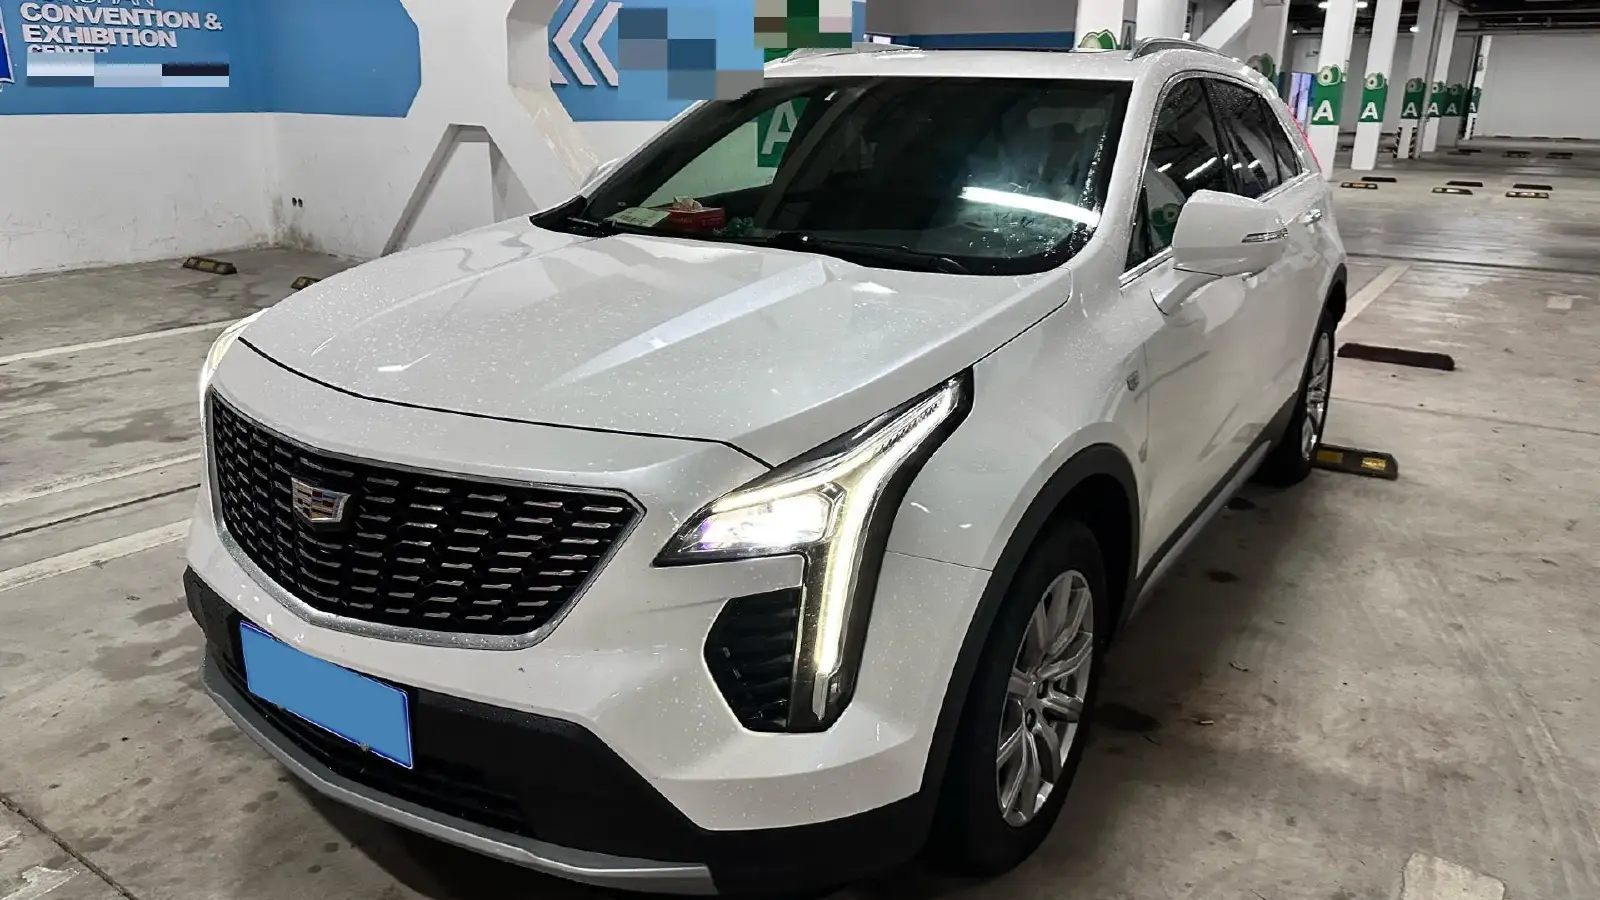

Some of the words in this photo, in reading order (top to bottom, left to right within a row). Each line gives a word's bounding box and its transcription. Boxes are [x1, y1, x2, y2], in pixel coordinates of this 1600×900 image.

[20, 3, 200, 29] CONVENTION
[204, 13, 223, 30] &
[22, 24, 178, 48] EXHIBITION
[1312, 100, 1334, 122] A
[1361, 102, 1379, 120] A
[1402, 102, 1418, 117] A
[1427, 102, 1440, 115] A
[1445, 102, 1458, 115] A
[1469, 101, 1477, 112] A
[761, 100, 799, 154] A
